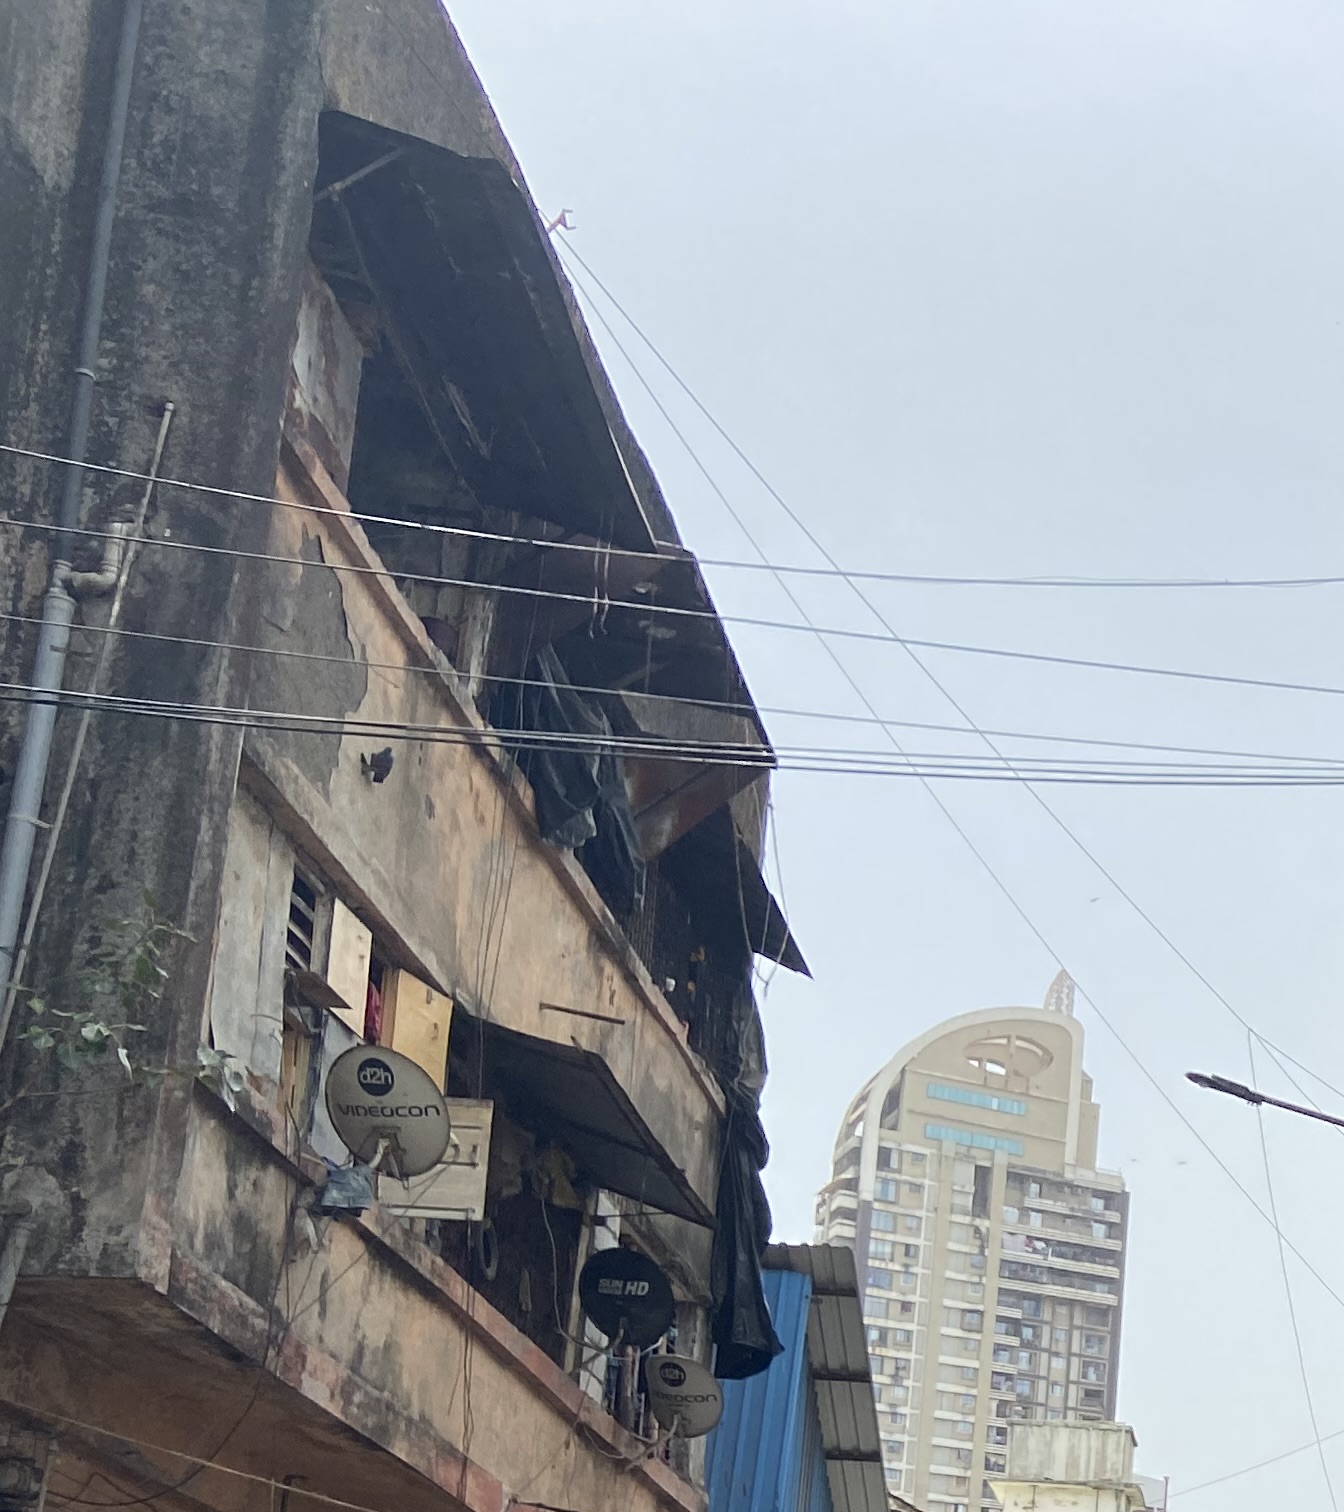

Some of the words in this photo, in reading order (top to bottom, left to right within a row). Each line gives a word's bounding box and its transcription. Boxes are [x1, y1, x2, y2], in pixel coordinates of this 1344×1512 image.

[360, 1067, 392, 1085] d2h
[338, 1104, 441, 1118] VIDEOCON
[624, 1282, 649, 1296] HD
